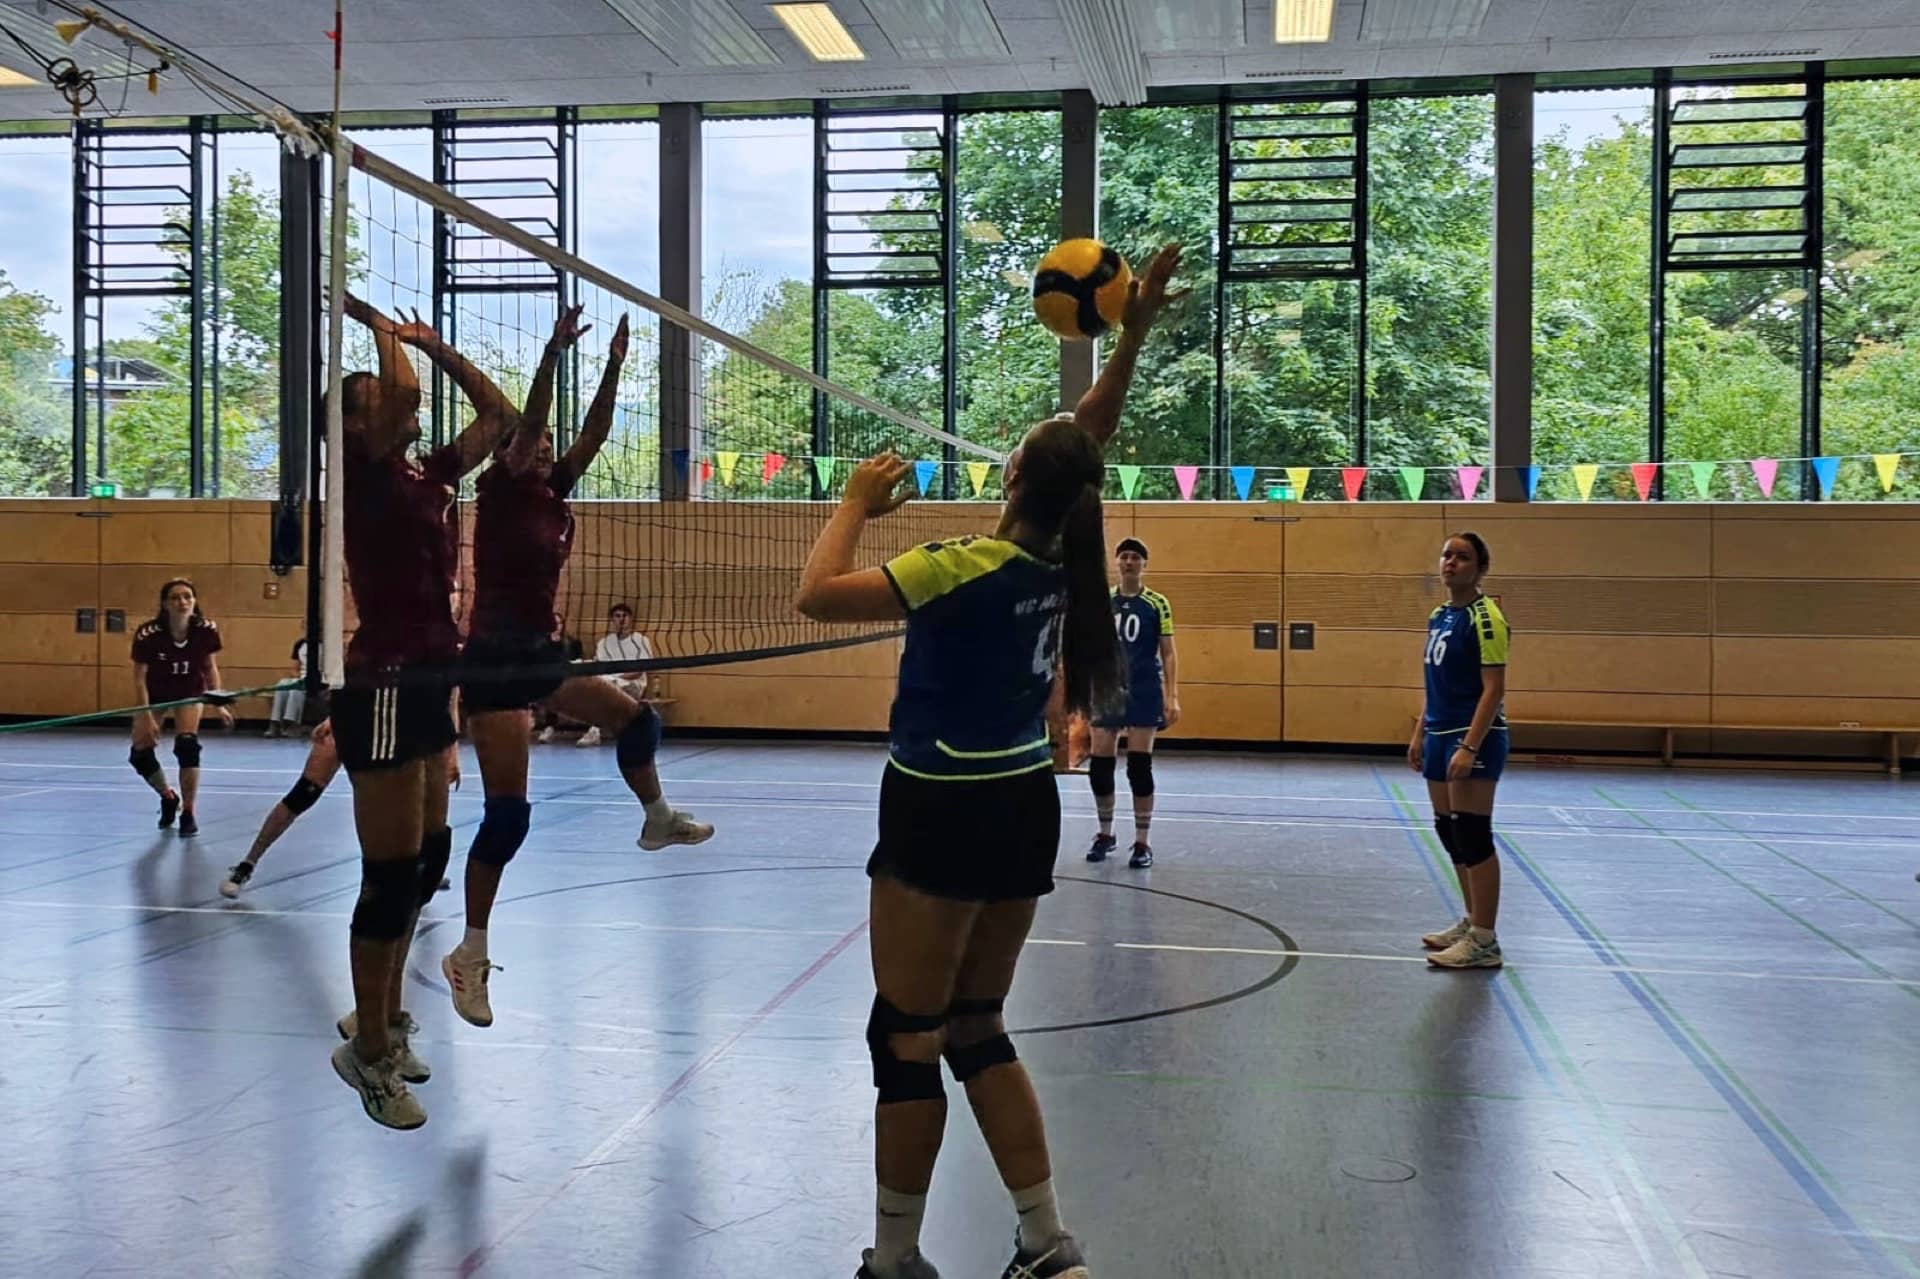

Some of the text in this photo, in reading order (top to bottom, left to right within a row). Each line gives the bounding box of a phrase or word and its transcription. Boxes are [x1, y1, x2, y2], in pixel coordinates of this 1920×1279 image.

[1114, 612, 1140, 642] 10
[1424, 629, 1452, 666] 16
[171, 661, 190, 675] 11
